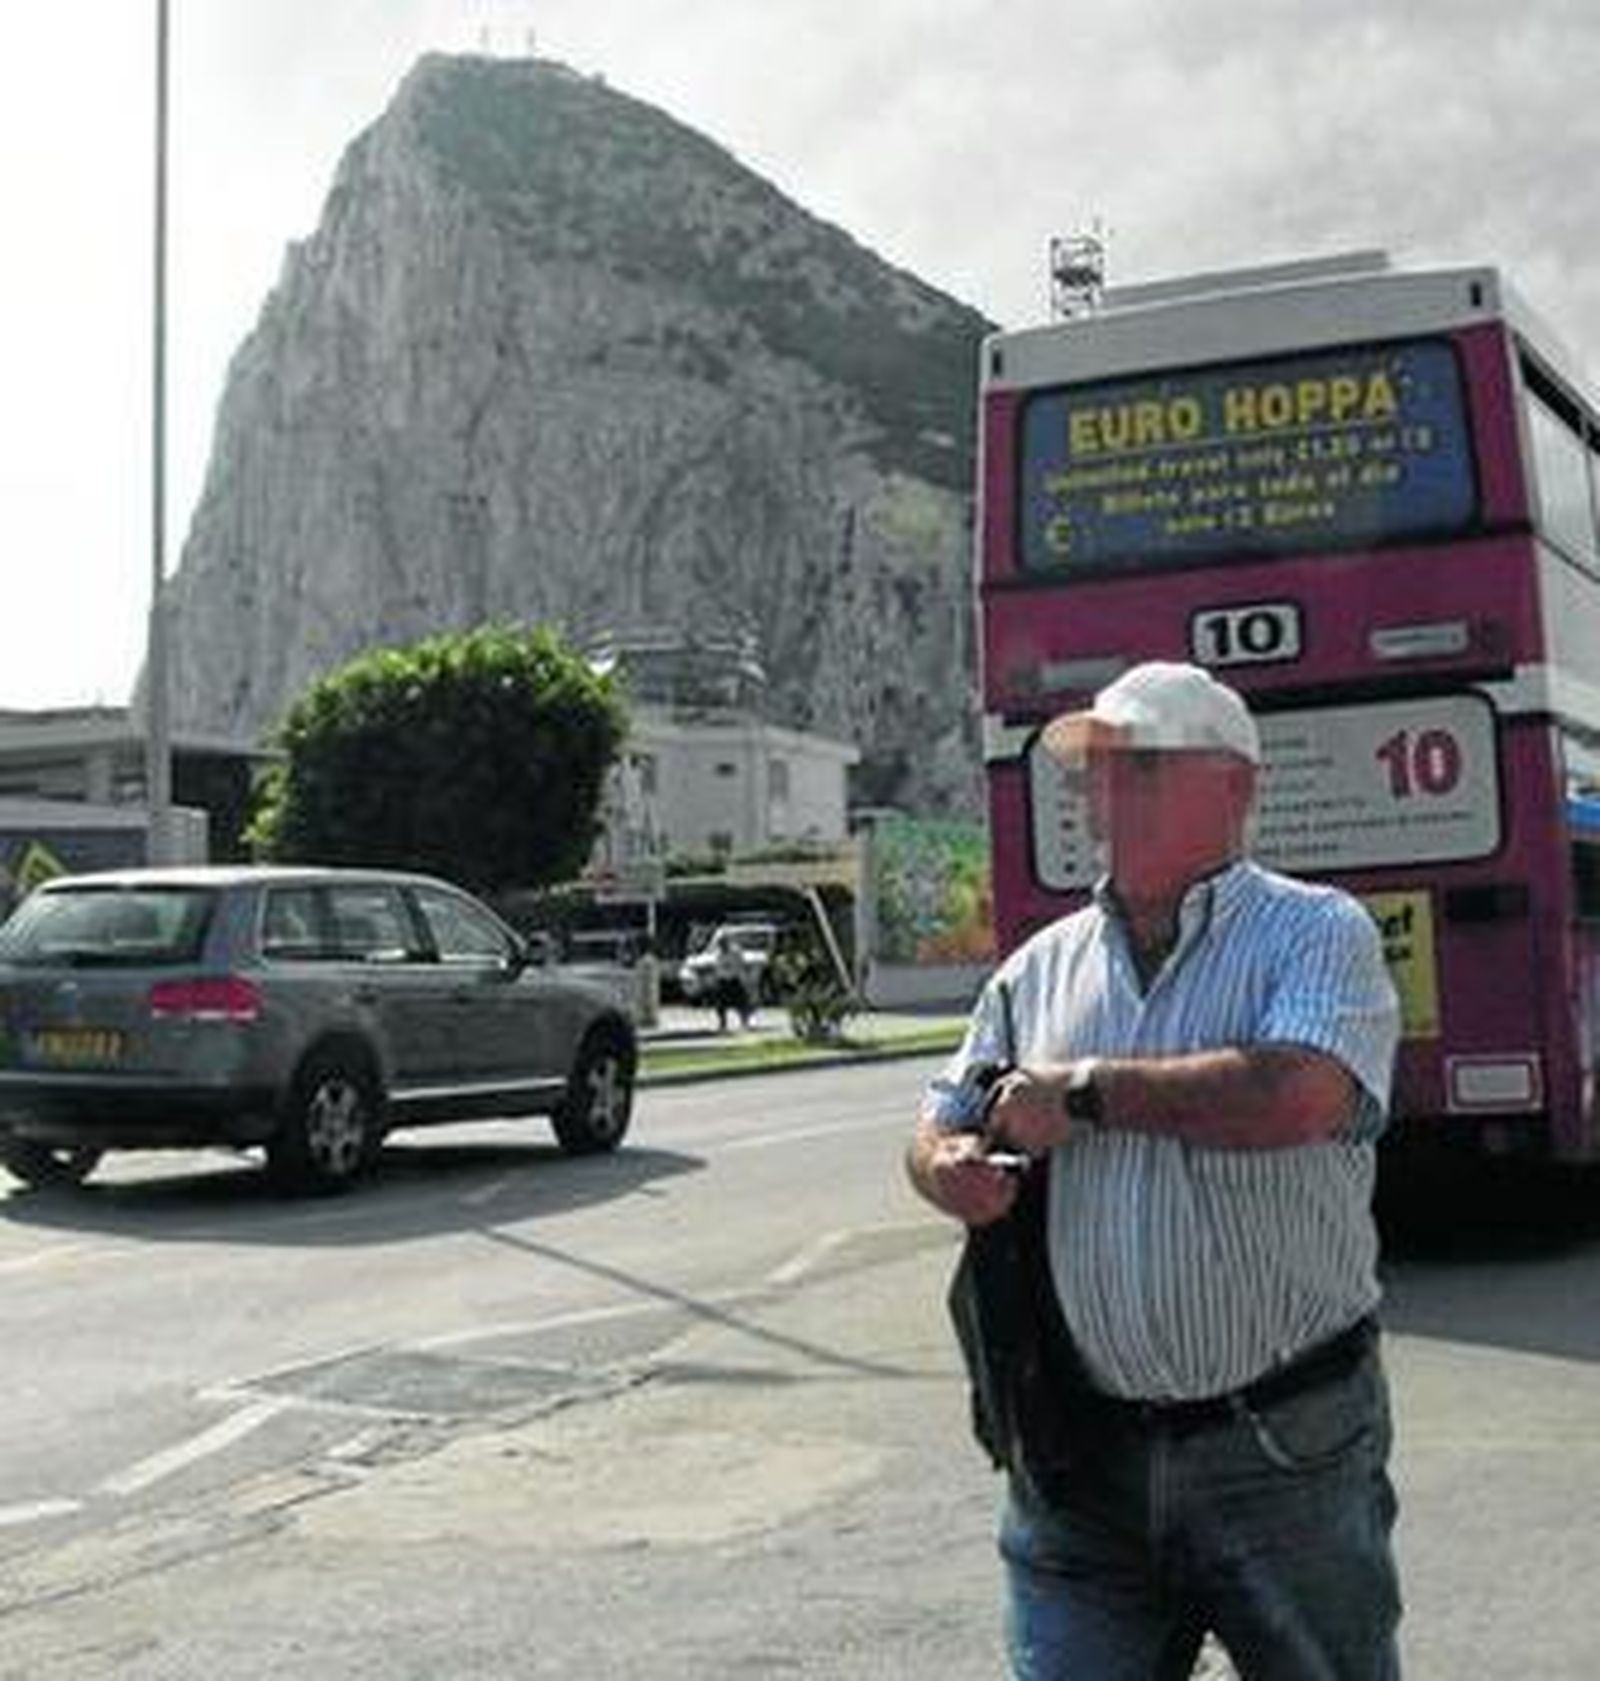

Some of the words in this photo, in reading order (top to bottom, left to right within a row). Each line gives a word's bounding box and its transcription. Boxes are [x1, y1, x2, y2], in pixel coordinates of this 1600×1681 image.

[1069, 397, 1201, 455] EURO
[1224, 373, 1396, 433] HOPPA
[1203, 610, 1284, 658] 10
[1375, 728, 1463, 799] 10
